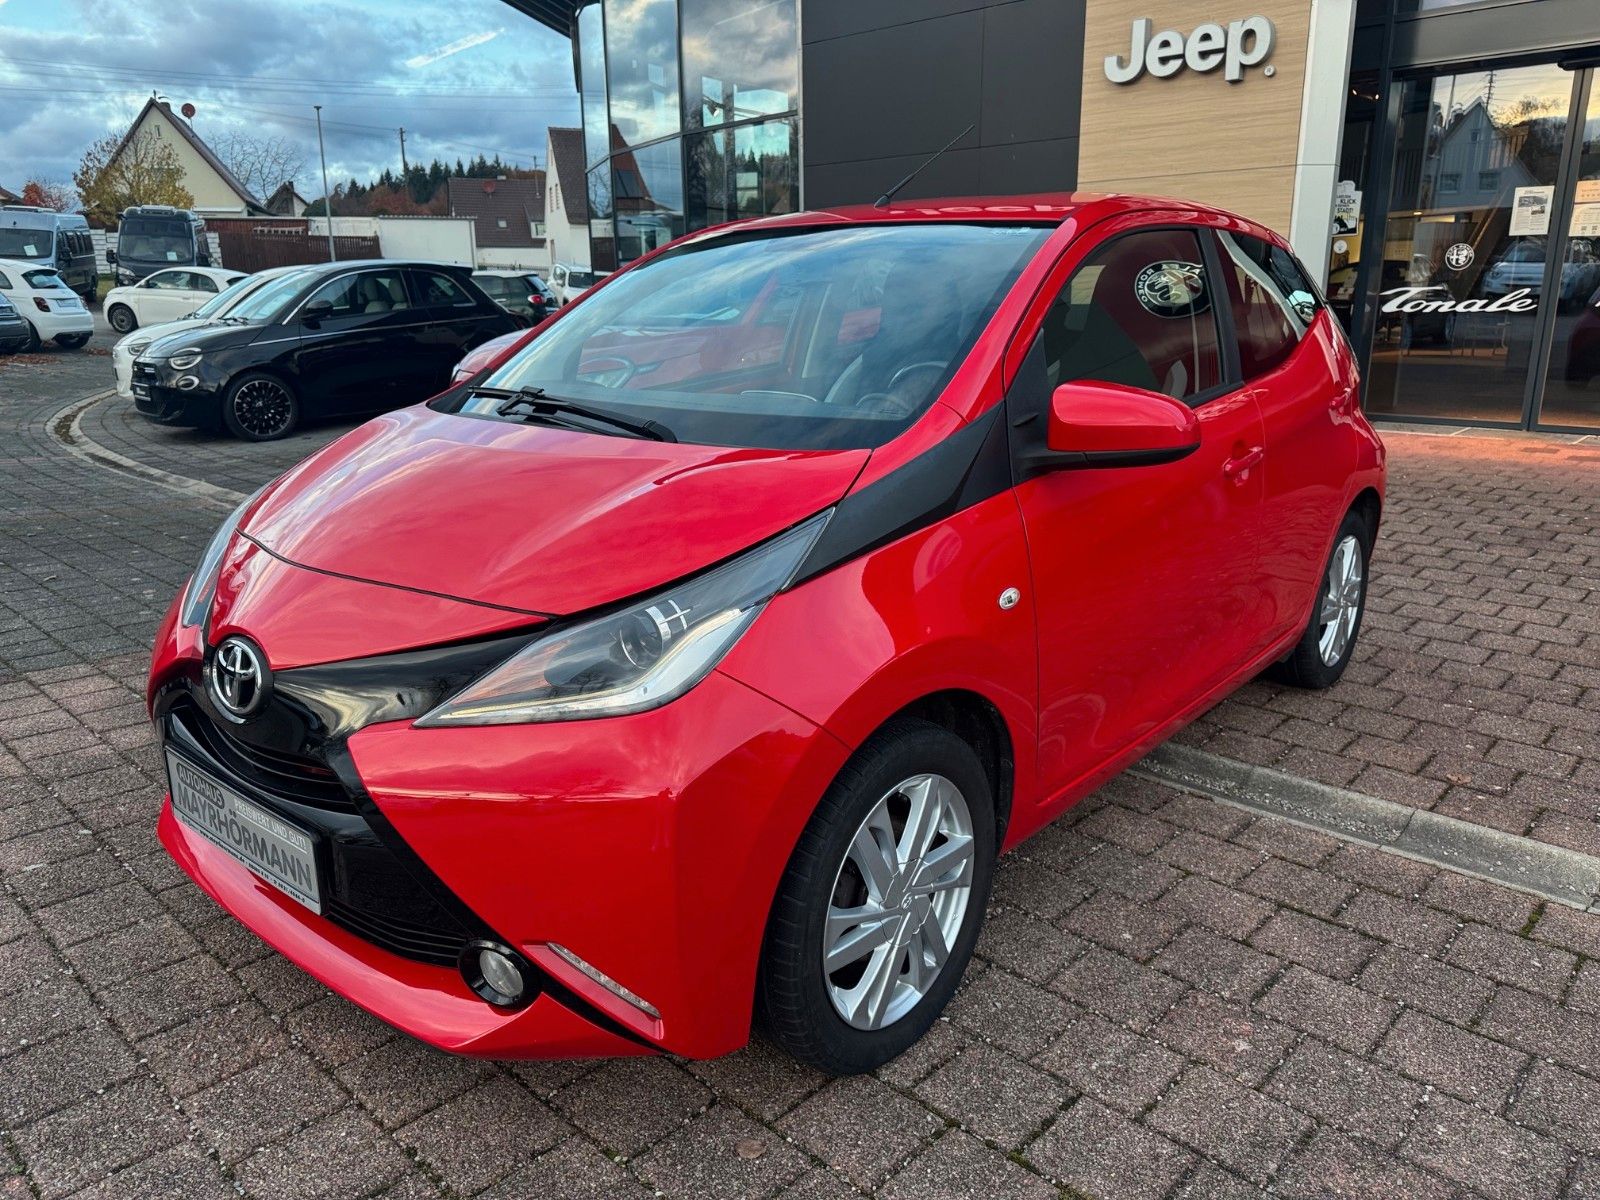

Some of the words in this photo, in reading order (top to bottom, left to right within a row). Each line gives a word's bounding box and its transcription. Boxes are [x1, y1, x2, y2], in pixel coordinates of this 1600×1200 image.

[1104, 15, 1275, 83] Jeep
[1379, 286, 1537, 313] Tonale
[179, 767, 223, 804] AUTOHAUS
[178, 783, 312, 892] MAYRHÖRMANN
[235, 799, 270, 829] PREISWERT
[271, 821, 287, 838] UND
[288, 830, 306, 849] GUT!
